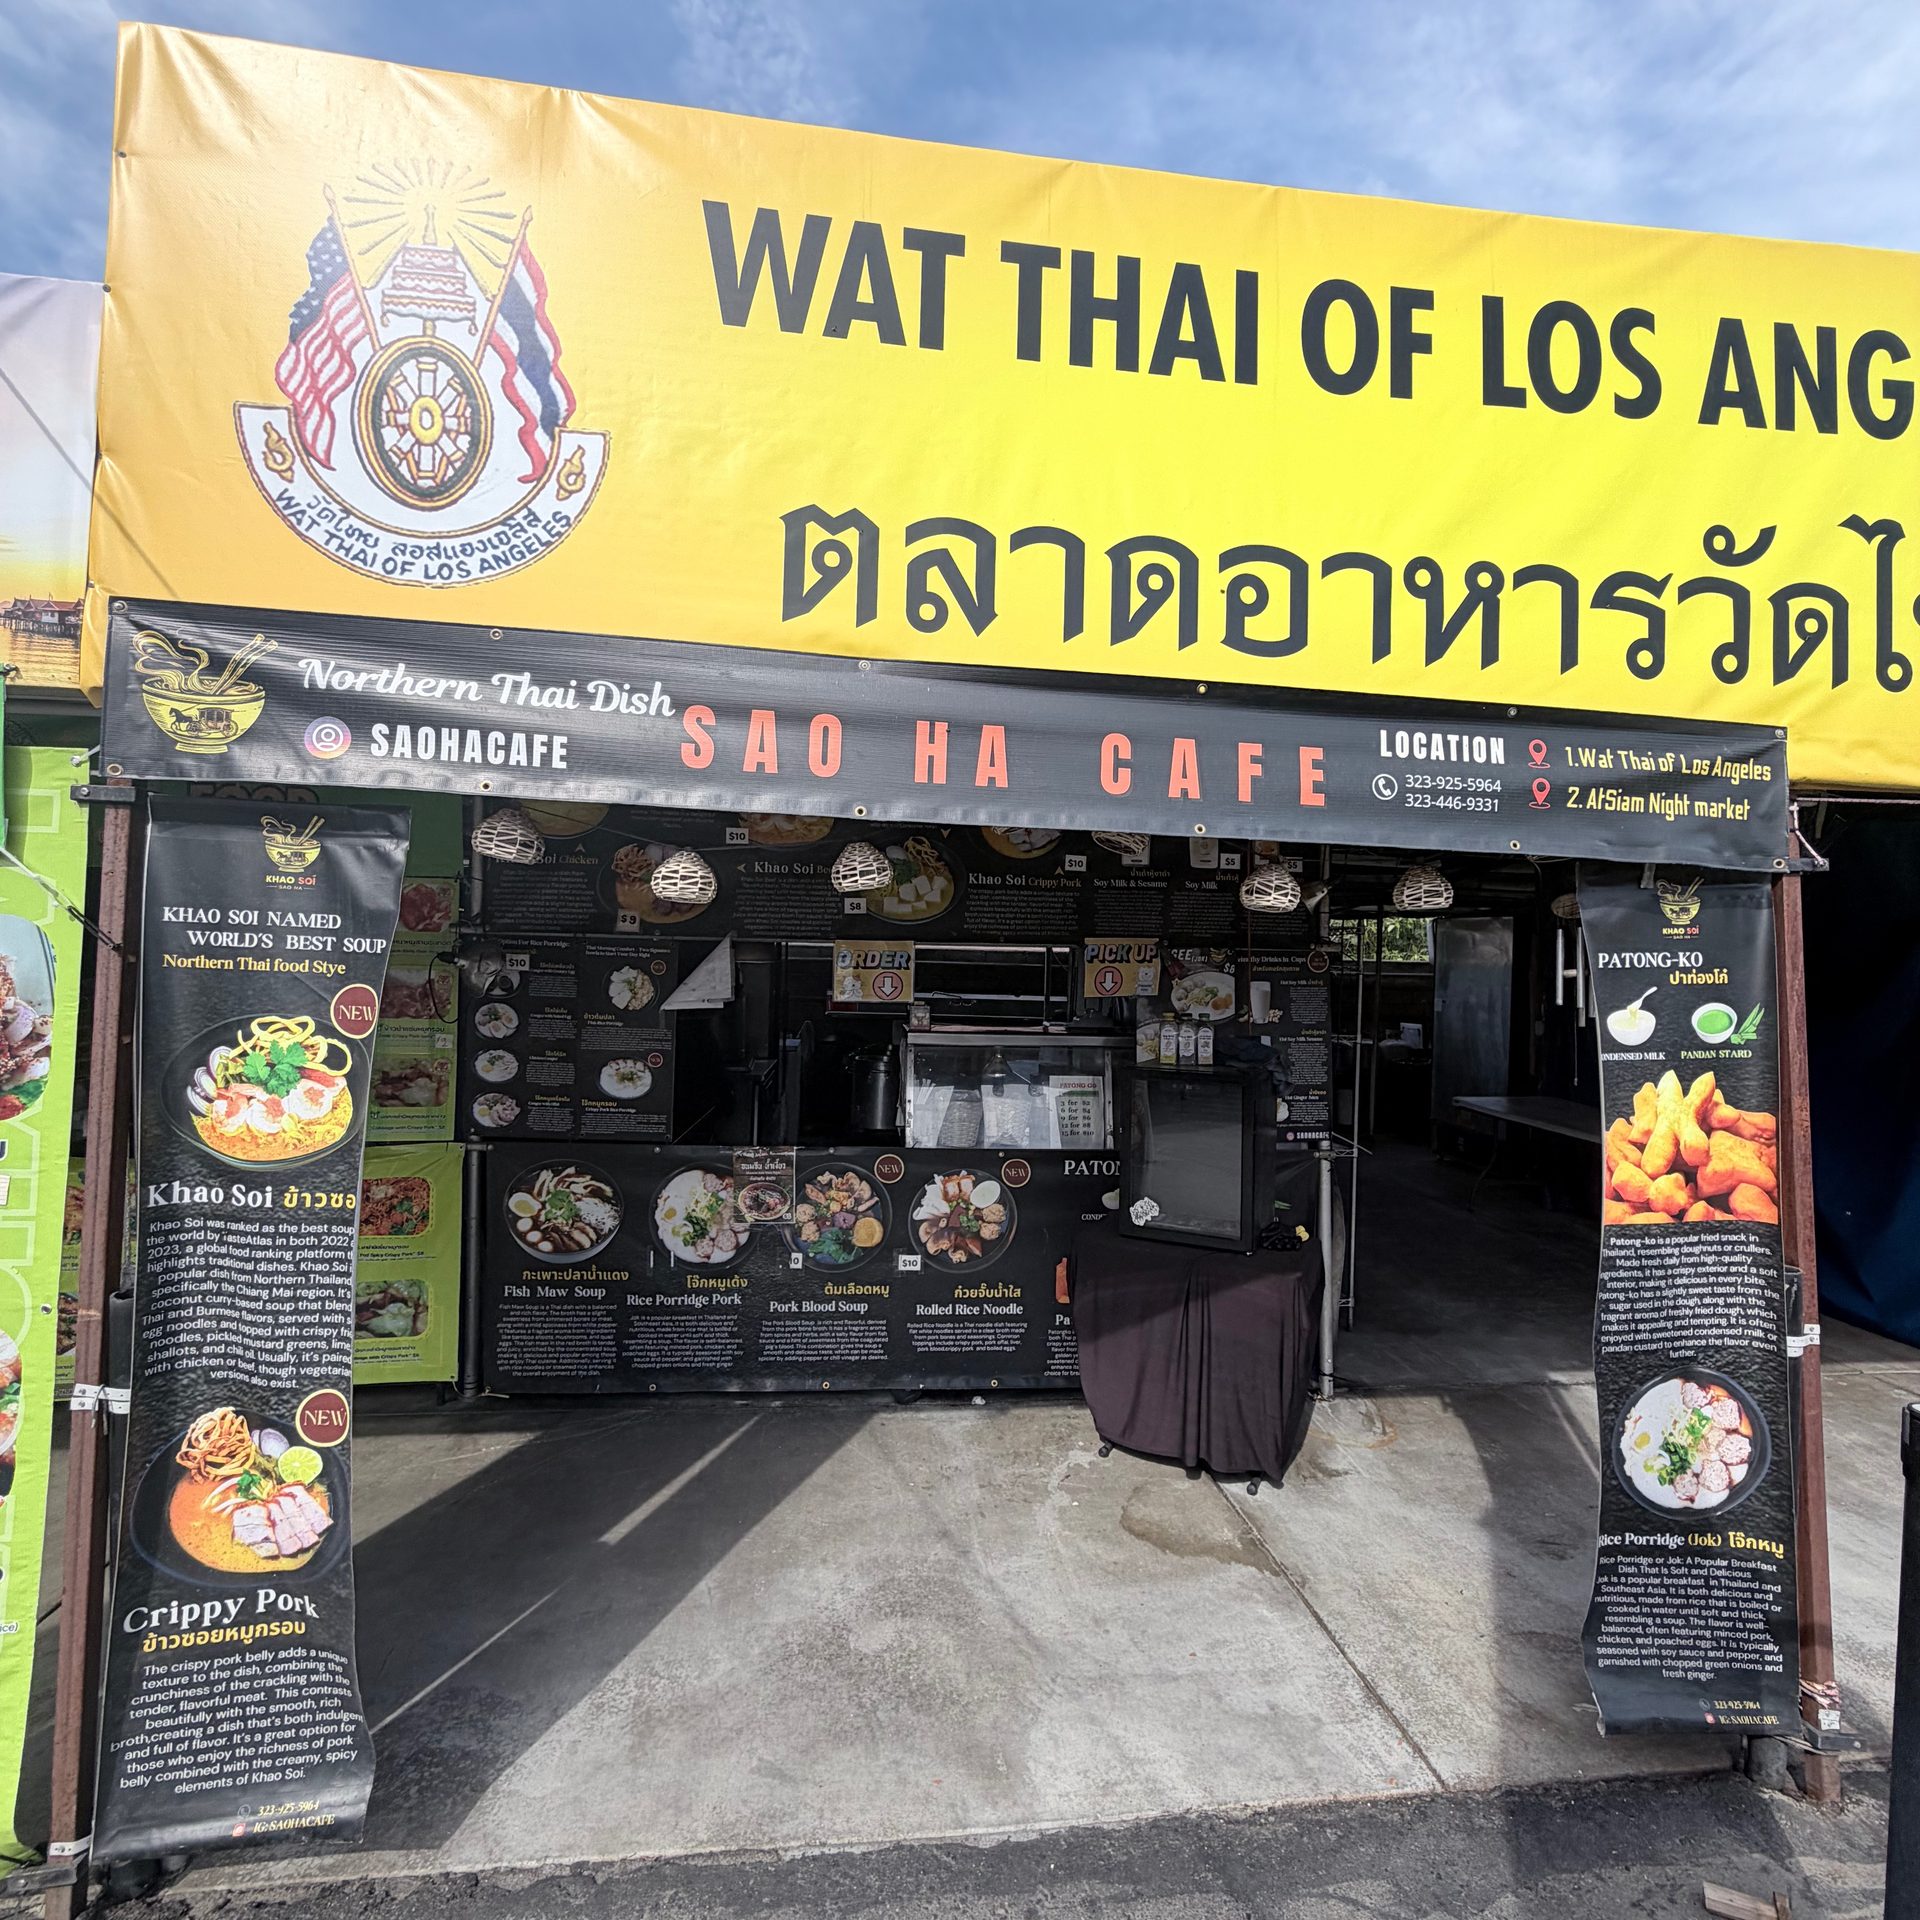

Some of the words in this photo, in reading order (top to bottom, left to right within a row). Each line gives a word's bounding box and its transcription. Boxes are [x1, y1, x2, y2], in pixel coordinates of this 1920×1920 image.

[702, 200, 965, 350] WAT
[1001, 241, 1258, 385] THAI
[1301, 279, 1434, 399] OF
[1481, 295, 1662, 419] LOS
[275, 488, 321, 531] WAT
[324, 529, 378, 567] THAI
[381, 557, 416, 576] OF
[424, 561, 471, 580] LOS
[479, 510, 572, 574] ANGELES
[780, 504, 1920, 693] ตลาดอาหารวัดไ
[298, 658, 484, 702] Northern
[491, 673, 580, 710] Thai
[587, 679, 676, 717] Dish
[371, 723, 568, 770] SAOHACAFE
[1379, 730, 1505, 765] LOCATION
[680, 704, 843, 779] SAO
[915, 720, 1008, 788] HA
[1100, 732, 1326, 808] CAFE
[1617, 750, 1656, 772] Thai
[1659, 754, 1675, 773] of
[1681, 755, 1710, 777] Los
[1711, 757, 1772, 785] Angeles
[1405, 774, 1502, 794] 323-925-5964
[1404, 793, 1500, 812] 323-446-9331
[1567, 787, 1583, 809] 2.
[1649, 793, 1691, 820] Night
[1694, 800, 1750, 821] market
[728, 831, 746, 841] $10
[754, 862, 788, 873] Khao
[793, 862, 814, 874] Soi
[1068, 859, 1084, 868] $10
[1225, 857, 1236, 866] $5
[1287, 860, 1298, 869] $5
[266, 875, 295, 884] KHAO
[969, 873, 1002, 885] Khao
[1006, 874, 1026, 886] Soi
[1060, 878, 1082, 887] Pork
[1094, 879, 1109, 888] Soy
[1110, 879, 1128, 887] Milk
[1138, 880, 1167, 888] Sesame
[1185, 881, 1200, 890] Soy
[1201, 881, 1218, 889] Milk
[849, 901, 862, 911] $8
[162, 907, 220, 924] KHAO
[228, 910, 258, 925] SOI
[267, 912, 341, 929] NAMED
[286, 935, 336, 951] BEST
[343, 937, 387, 954] SOUP
[1086, 943, 1132, 963] PICK
[1133, 943, 1158, 963] UP
[162, 954, 234, 970] Northern
[237, 957, 271, 971] Thai
[273, 958, 309, 973] food
[313, 960, 346, 977] Stye
[508, 958, 526, 967] $10
[836, 949, 911, 970] ORDER
[1598, 952, 1704, 968] PATONG-KO
[339, 1004, 376, 1021] NEW
[1644, 1052, 1666, 1061] MILK
[1680, 1050, 1716, 1059] PANDAN
[1718, 1049, 1752, 1058] STARD
[878, 1164, 901, 1175] NEW
[1005, 1168, 1028, 1178] NEW
[147, 1180, 224, 1208] Khao
[232, 1184, 273, 1208] Soi
[150, 1221, 181, 1232] Khao
[184, 1217, 204, 1227] Soi
[207, 1220, 225, 1228] was
[227, 1222, 259, 1232] ranked
[262, 1225, 275, 1233] as
[279, 1223, 298, 1233] the
[301, 1223, 328, 1233] best
[331, 1225, 355, 1236] soup
[902, 1259, 918, 1267] $10
[504, 1285, 531, 1297] Fish
[536, 1286, 569, 1297] Maw
[574, 1286, 606, 1300] Soup
[824, 1281, 889, 1298] ต้มเลือดหมู
[626, 1294, 653, 1306] Rice
[656, 1293, 709, 1308] Porridge
[712, 1293, 742, 1305] Pork
[769, 1301, 799, 1312] Pork
[802, 1300, 836, 1311] Blood
[838, 1301, 869, 1315] Soup
[916, 1304, 953, 1315] Rolled
[955, 1304, 980, 1315] Rice
[983, 1303, 1023, 1315] Noodle
[303, 1408, 347, 1426] NEW
[1598, 1533, 1622, 1547] Rice
[1624, 1532, 1685, 1549] Porridge
[1688, 1533, 1722, 1546] (Jok)
[1728, 1531, 1784, 1559] โจ๊กหมู
[1617, 1555, 1653, 1565] Porridge
[1666, 1556, 1684, 1564] Jok:
[1686, 1556, 1693, 1565] A
[1694, 1556, 1728, 1566] Popular
[1731, 1559, 1777, 1572] Breakfast
[123, 1597, 246, 1633] Crippy
[255, 1588, 319, 1619] Pork
[142, 1620, 306, 1653] ข้าวซอยหมูกรอบ
[143, 1665, 168, 1676] The
[171, 1659, 211, 1673] crispy
[214, 1655, 242, 1669] pork
[245, 1650, 275, 1664] belly
[278, 1647, 307, 1658] adds
[318, 1650, 348, 1664] unique
